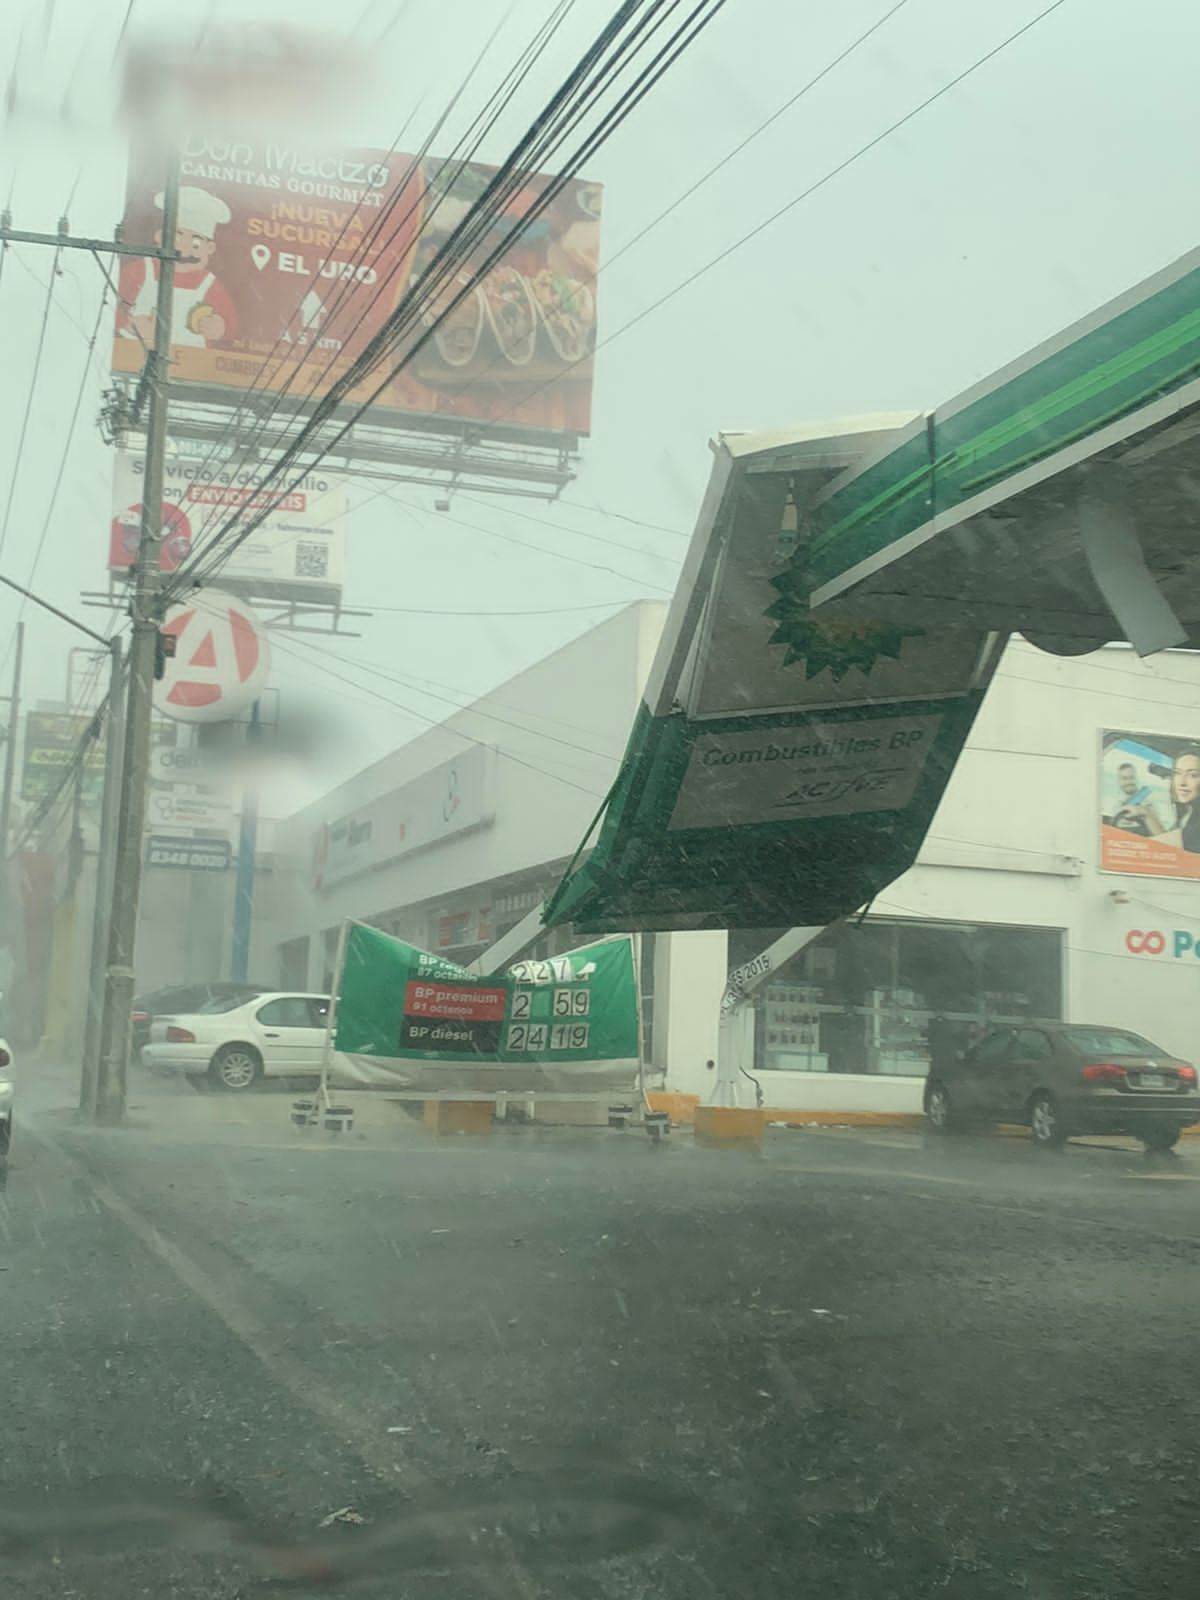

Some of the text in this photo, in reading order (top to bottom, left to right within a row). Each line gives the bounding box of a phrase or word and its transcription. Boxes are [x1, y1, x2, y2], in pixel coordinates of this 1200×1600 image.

[182, 161, 280, 188] CARNITAS
[279, 252, 376, 284] EL URO
[132, 461, 214, 482] Svicio
[219, 471, 230, 483] a
[704, 730, 923, 766] Combustibles BP
[419, 954, 437, 966] BP
[415, 987, 498, 1004] BP premium
[412, 1002, 427, 1011] 91
[409, 1025, 473, 1041] BP diesel
